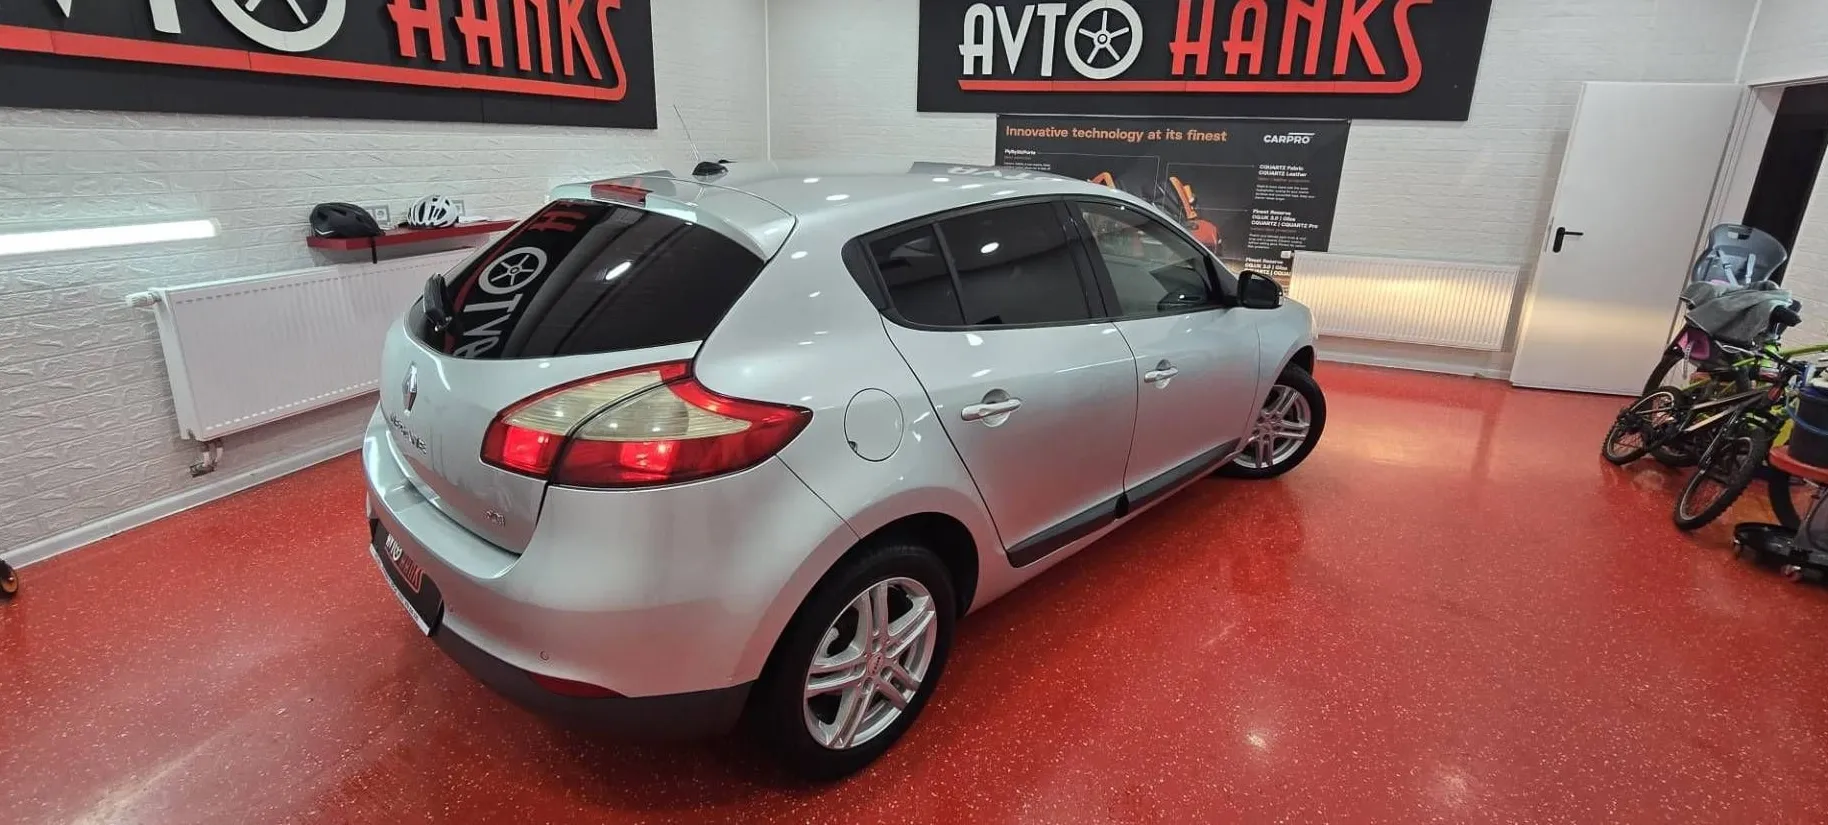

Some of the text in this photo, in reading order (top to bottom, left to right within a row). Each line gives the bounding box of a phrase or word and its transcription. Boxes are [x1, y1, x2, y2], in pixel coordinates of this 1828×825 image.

[959, 0, 1432, 93] AVTO HANKS
[1006, 126, 1228, 143] Innovative technology at its finest
[1263, 133, 1312, 144] CARPRO
